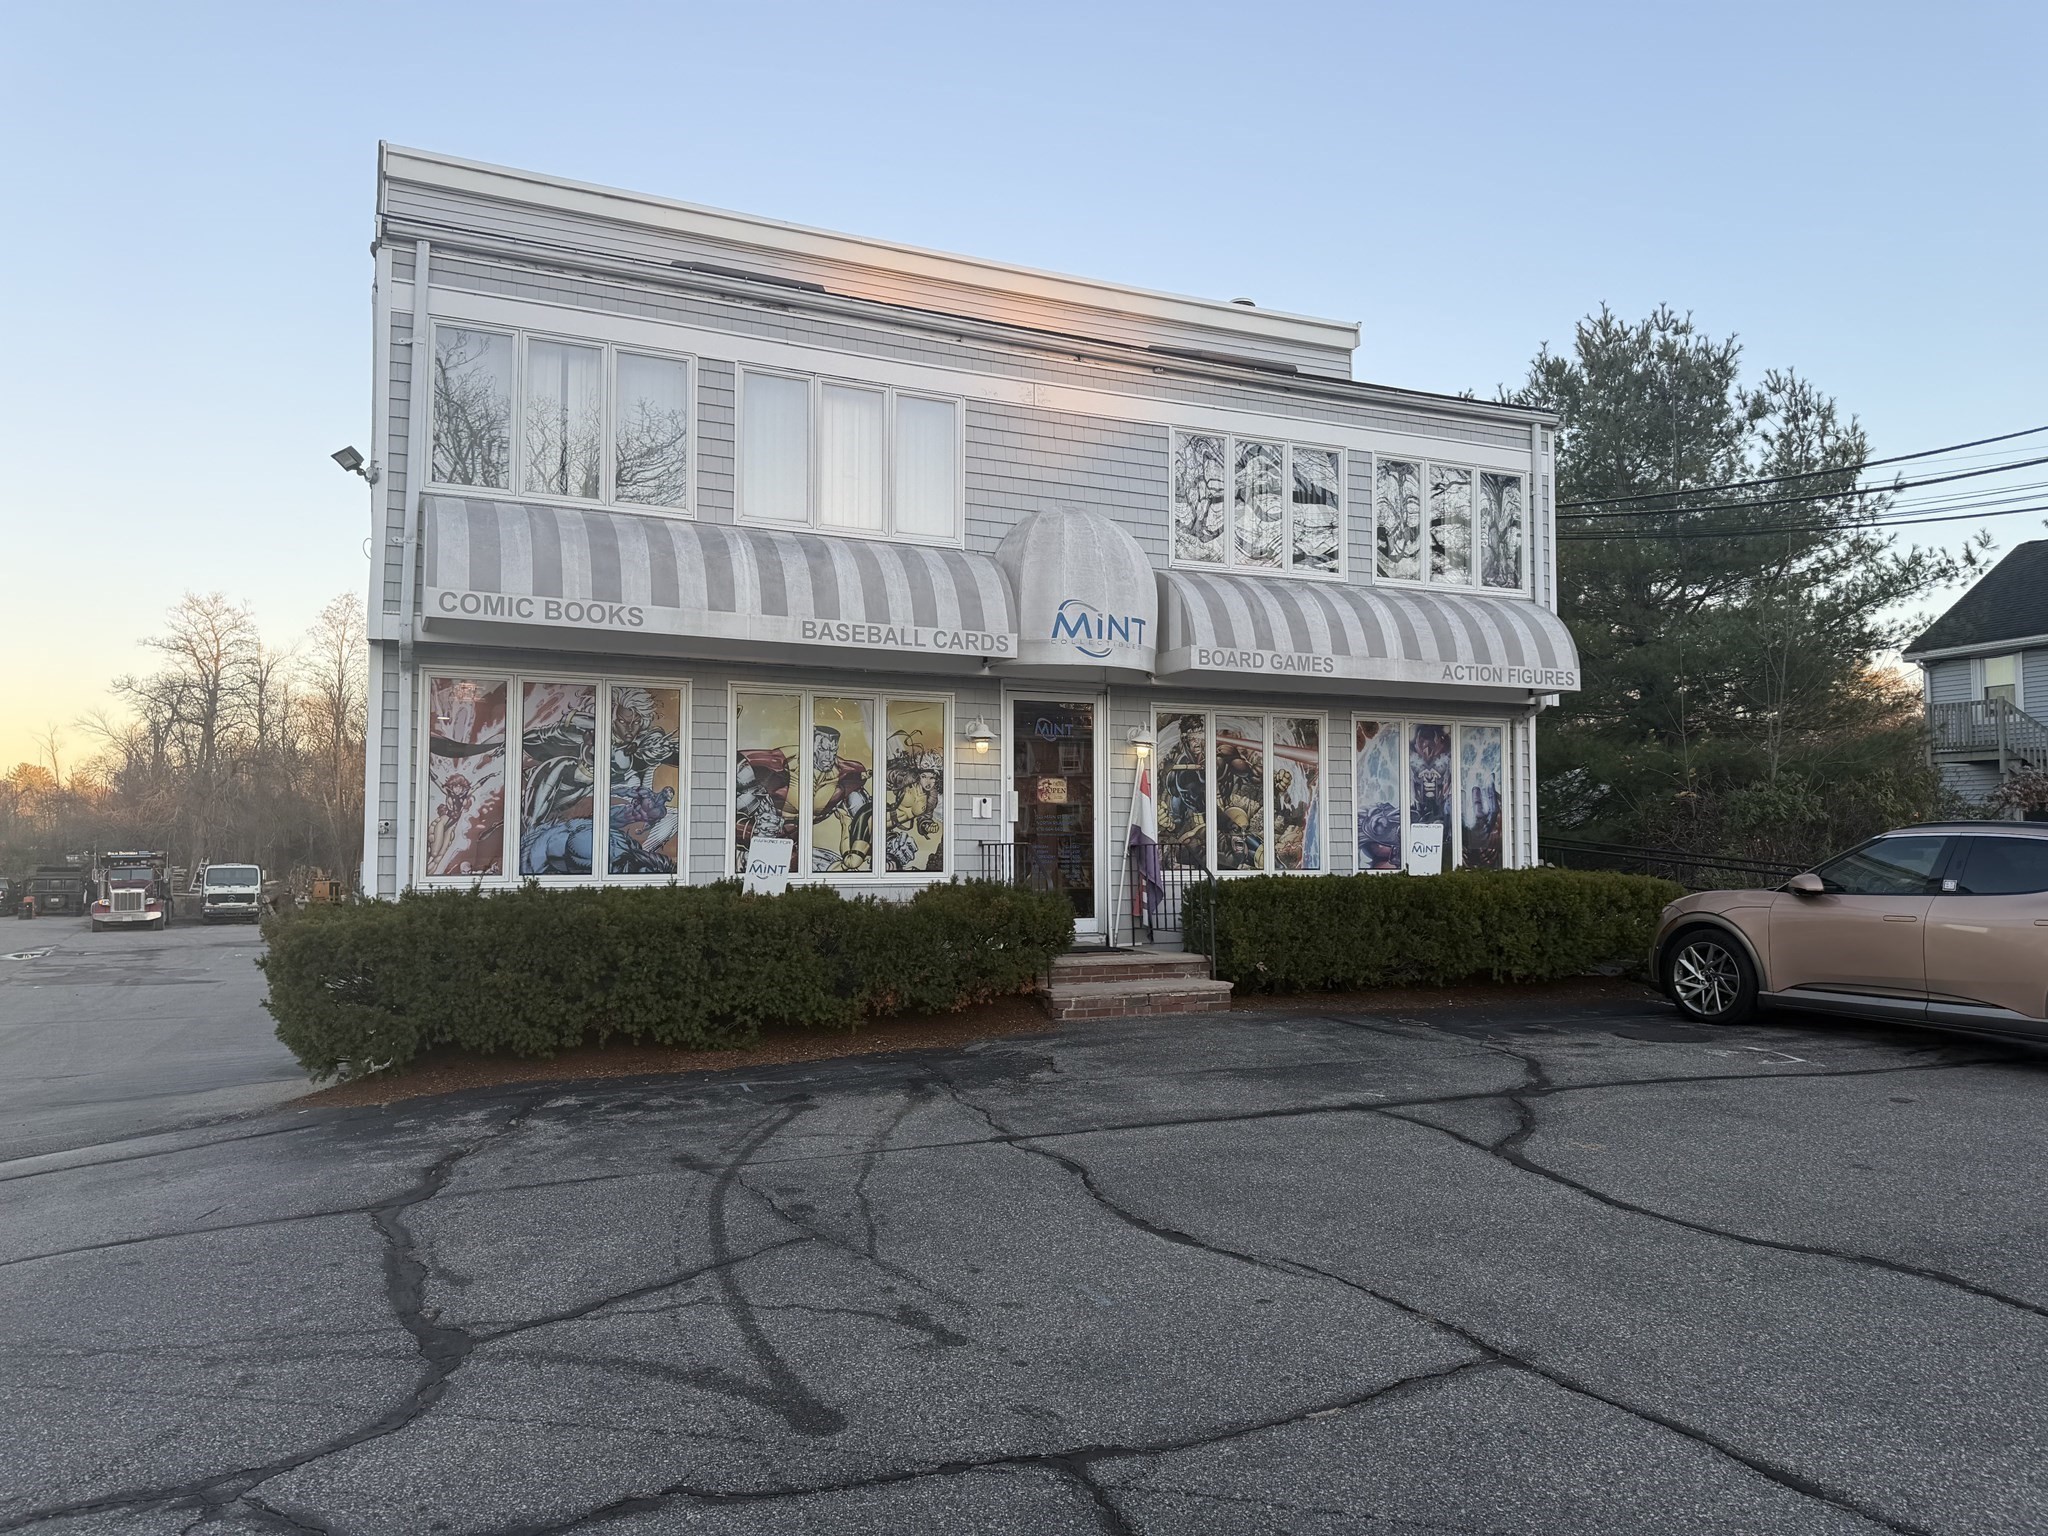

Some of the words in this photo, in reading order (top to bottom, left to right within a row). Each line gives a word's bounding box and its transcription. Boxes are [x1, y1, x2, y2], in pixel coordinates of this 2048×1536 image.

[438, 591, 534, 618] COMIC
[544, 600, 644, 626] BOOKS
[801, 620, 926, 647] BASEBALL
[933, 630, 1009, 652] CARDS
[1050, 639, 1142, 651] COLLECTIBLES
[1198, 649, 1265, 669] BOARD
[1270, 653, 1334, 673] GAMES
[1442, 664, 1502, 683] ACTION
[1508, 668, 1575, 686] FIGURES
